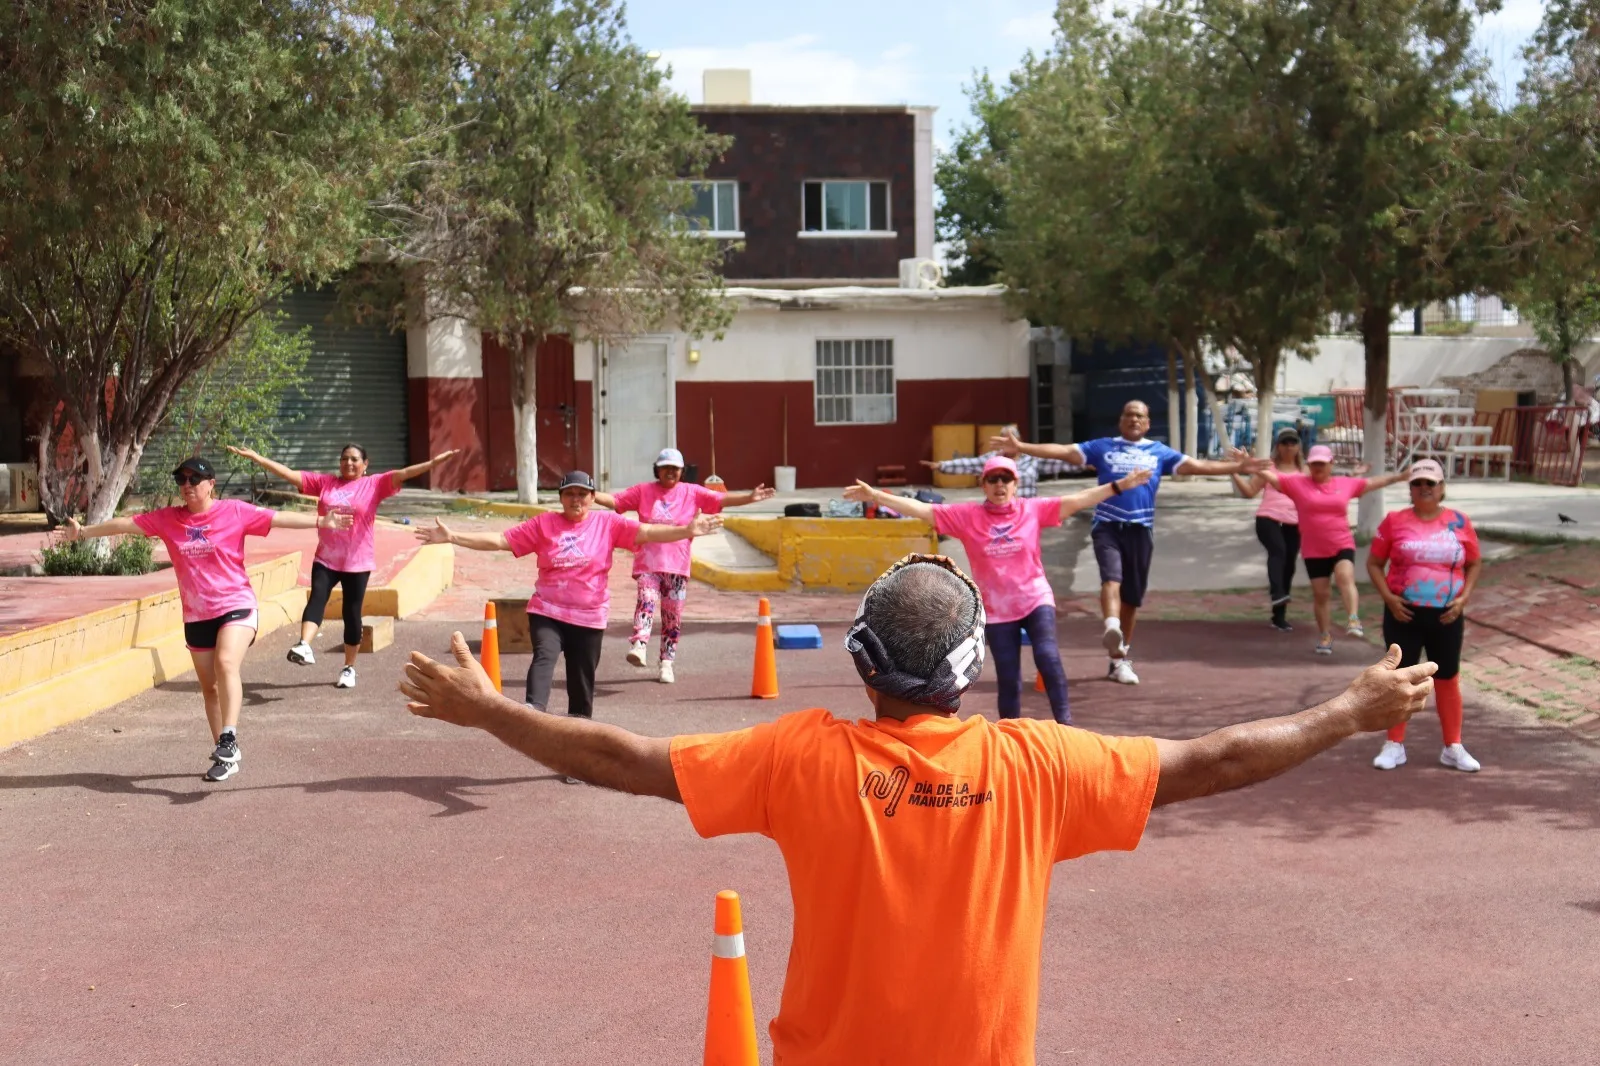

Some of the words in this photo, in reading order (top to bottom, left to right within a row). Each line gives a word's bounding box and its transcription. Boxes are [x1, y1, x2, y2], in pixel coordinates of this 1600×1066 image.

[914, 781, 933, 795] DÍA
[937, 784, 954, 796] DE
[956, 783, 969, 795] LA
